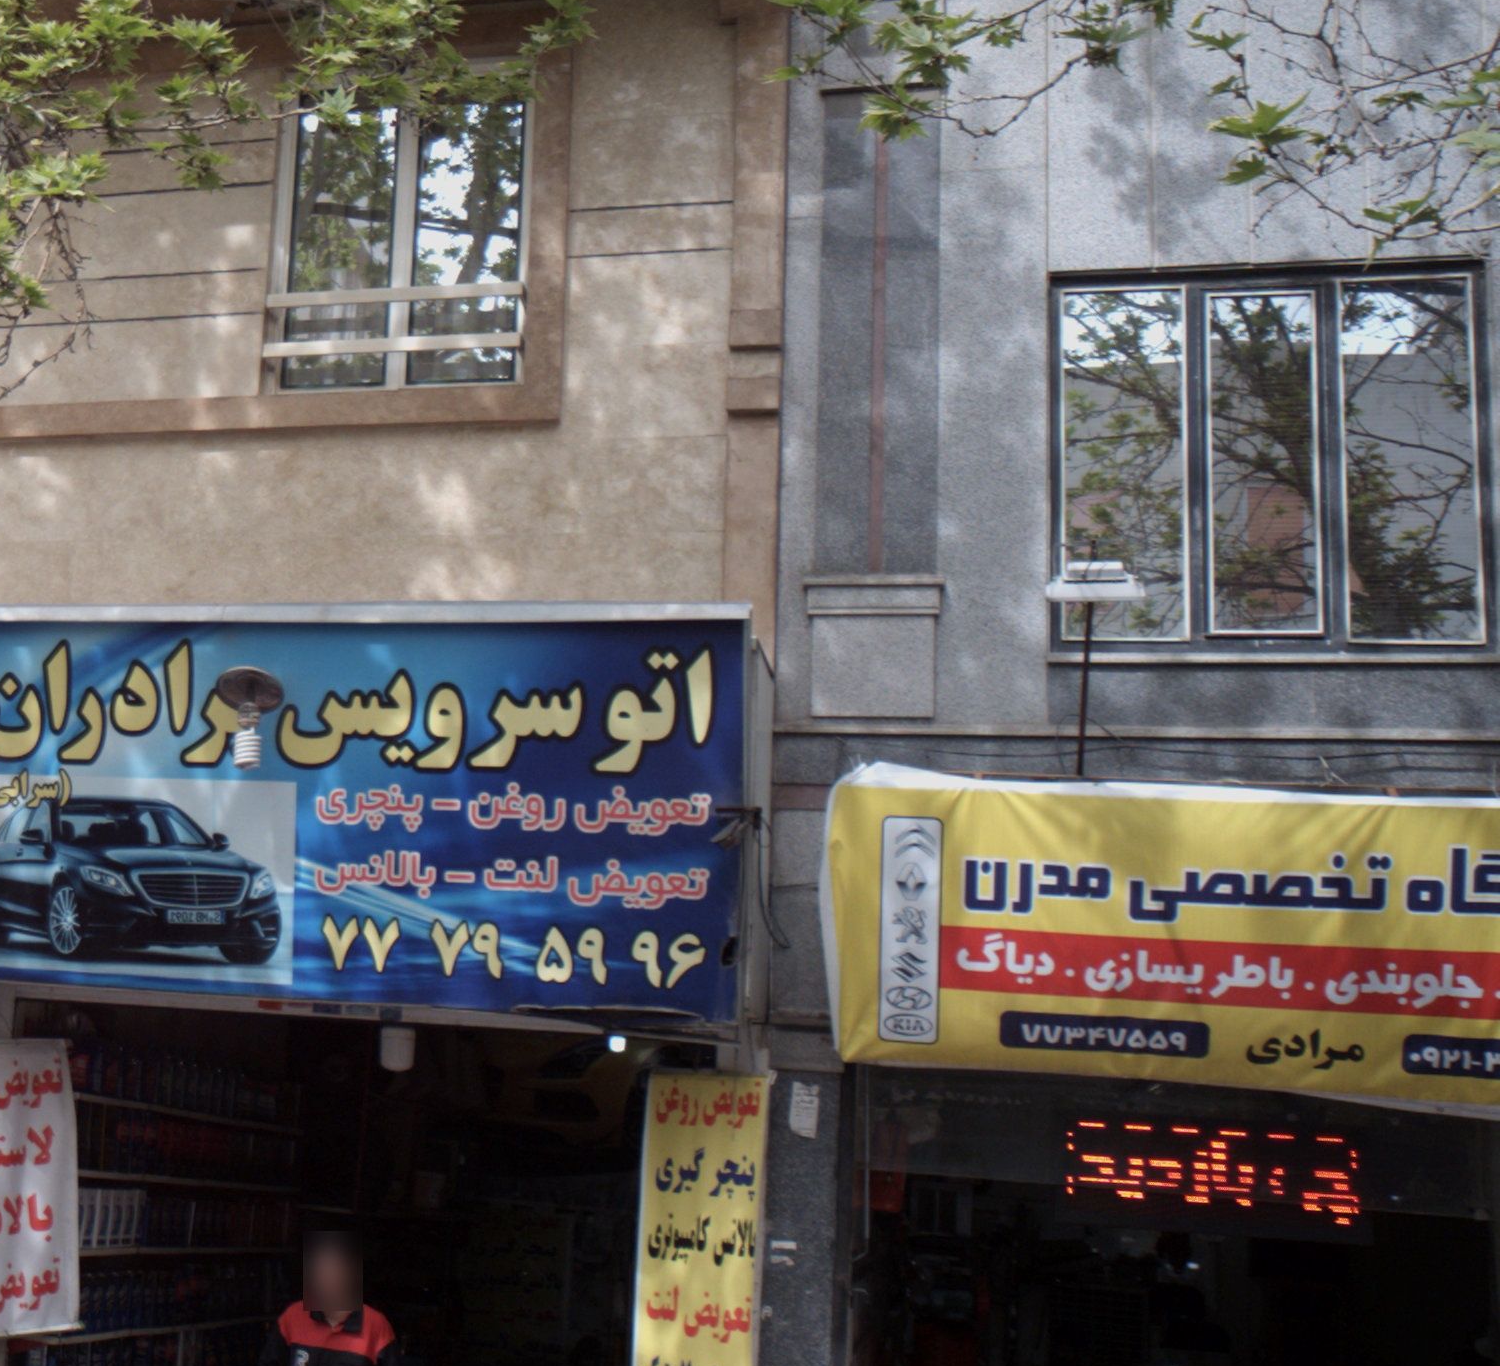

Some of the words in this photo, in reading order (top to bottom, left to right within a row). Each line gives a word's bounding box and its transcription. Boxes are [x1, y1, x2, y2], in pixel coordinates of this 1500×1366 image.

[277, 667, 584, 772] سرویس
[594, 646, 713, 774] اتو
[315, 784, 424, 832] پنچری
[468, 782, 567, 832] روغن
[574, 786, 712, 835] تعویض
[314, 850, 436, 898] بالانس
[485, 857, 558, 893] لنت
[568, 859, 710, 908] تعویض
[963, 856, 1111, 915] مدرن
[1128, 852, 1393, 923] تخصصی
[322, 915, 399, 973] ۷۷
[431, 918, 502, 979] ۷۹
[536, 926, 607, 985] ۵۹
[631, 931, 706, 989] ۹۶
[956, 933, 1055, 977] دیاگ
[1325, 962, 1484, 1009] جلوبندی
[892, 1018, 925, 1032] KIA
[1020, 1022, 1188, 1052] ۷۷۳۴۷۵۵۹
[1246, 1028, 1365, 1070] مرادی
[655, 1079, 699, 1126] روغن
[703, 1081, 761, 1129] تعویض
[655, 1147, 705, 1193] گیری
[710, 1155, 756, 1201] پنچر
[645, 1285, 680, 1321] لنت
[683, 1291, 752, 1344] تعویض
